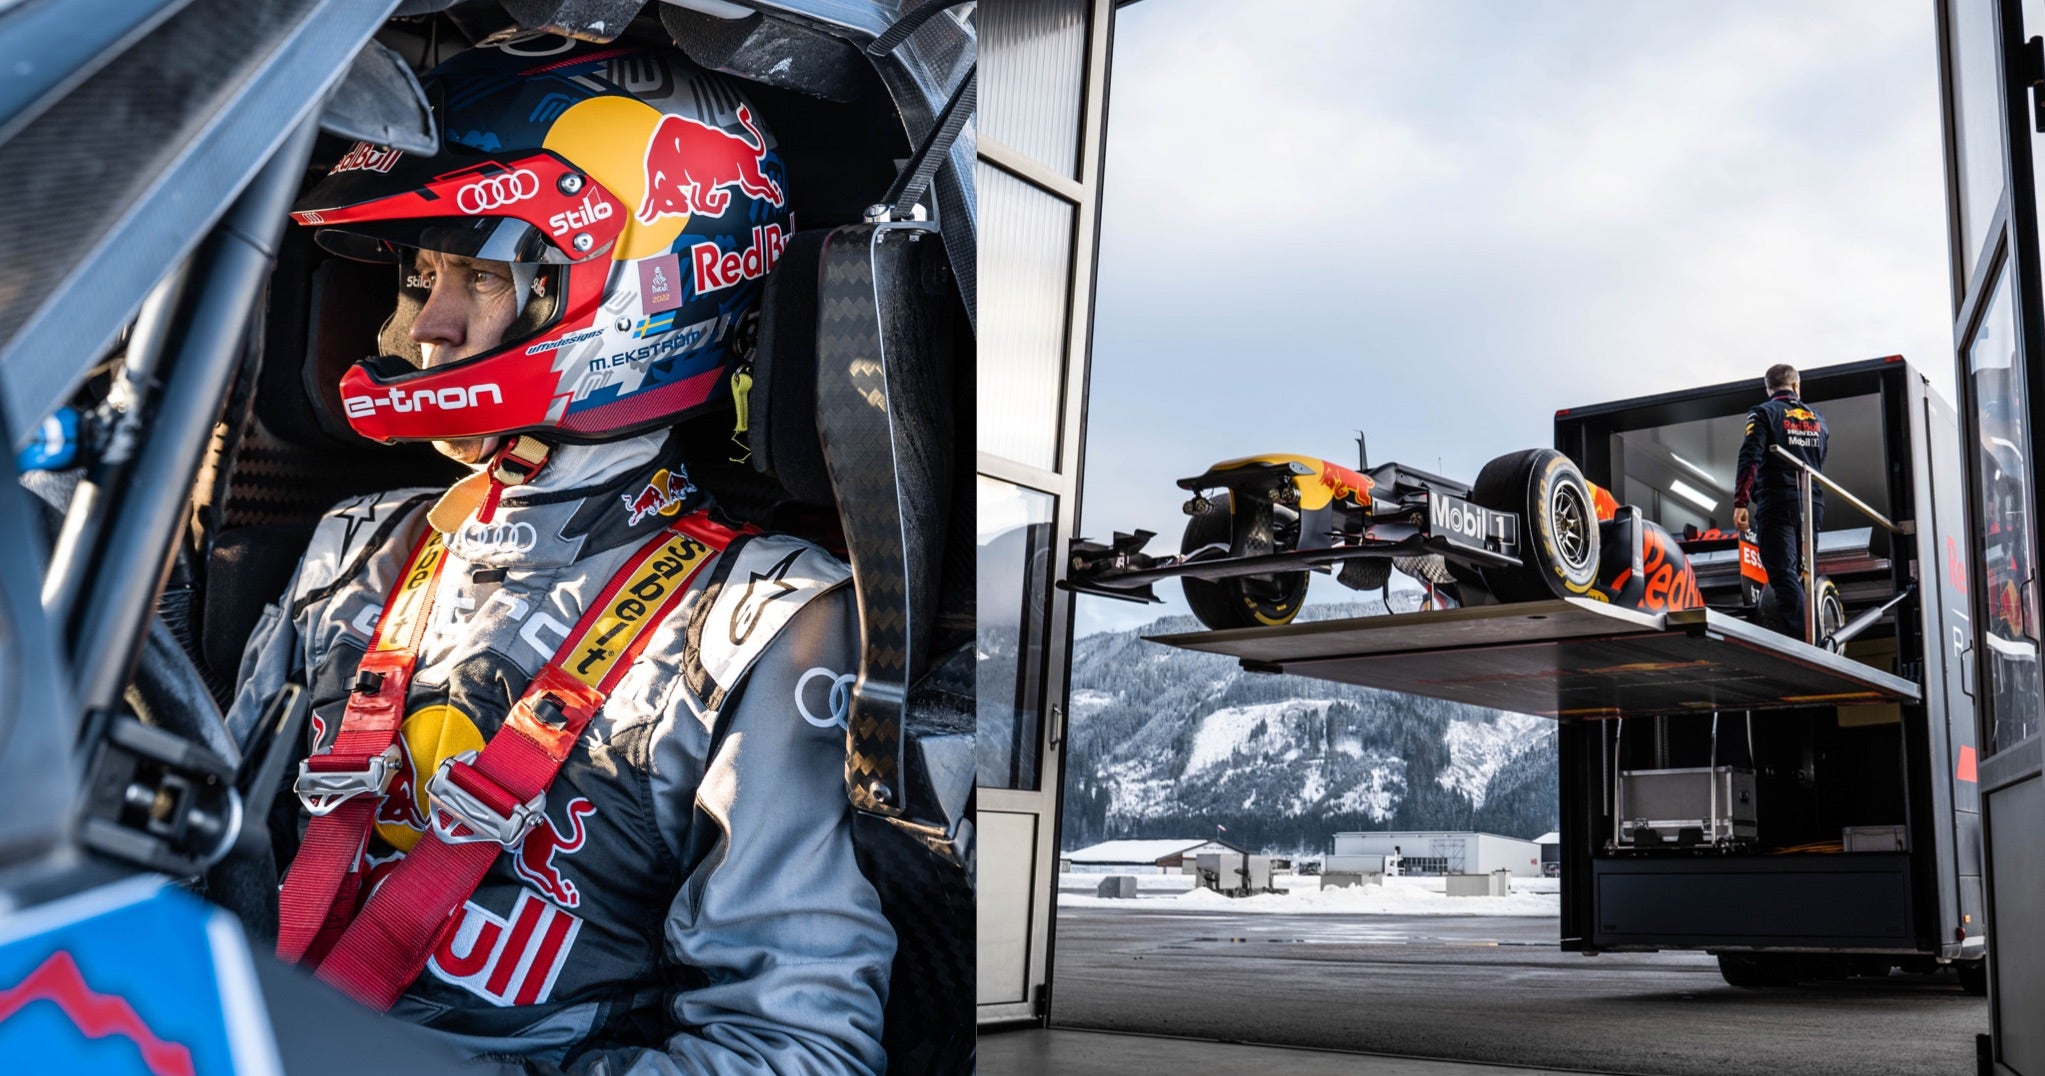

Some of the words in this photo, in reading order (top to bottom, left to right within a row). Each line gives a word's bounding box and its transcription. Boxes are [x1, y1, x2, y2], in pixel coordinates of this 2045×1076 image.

[652, 293, 671, 304] 2022
[344, 383, 503, 419] e-tron
[1431, 492, 1487, 541] Mobil
[390, 532, 443, 644] abelt
[577, 537, 707, 676] Sabelt
[428, 888, 583, 1007] ull
